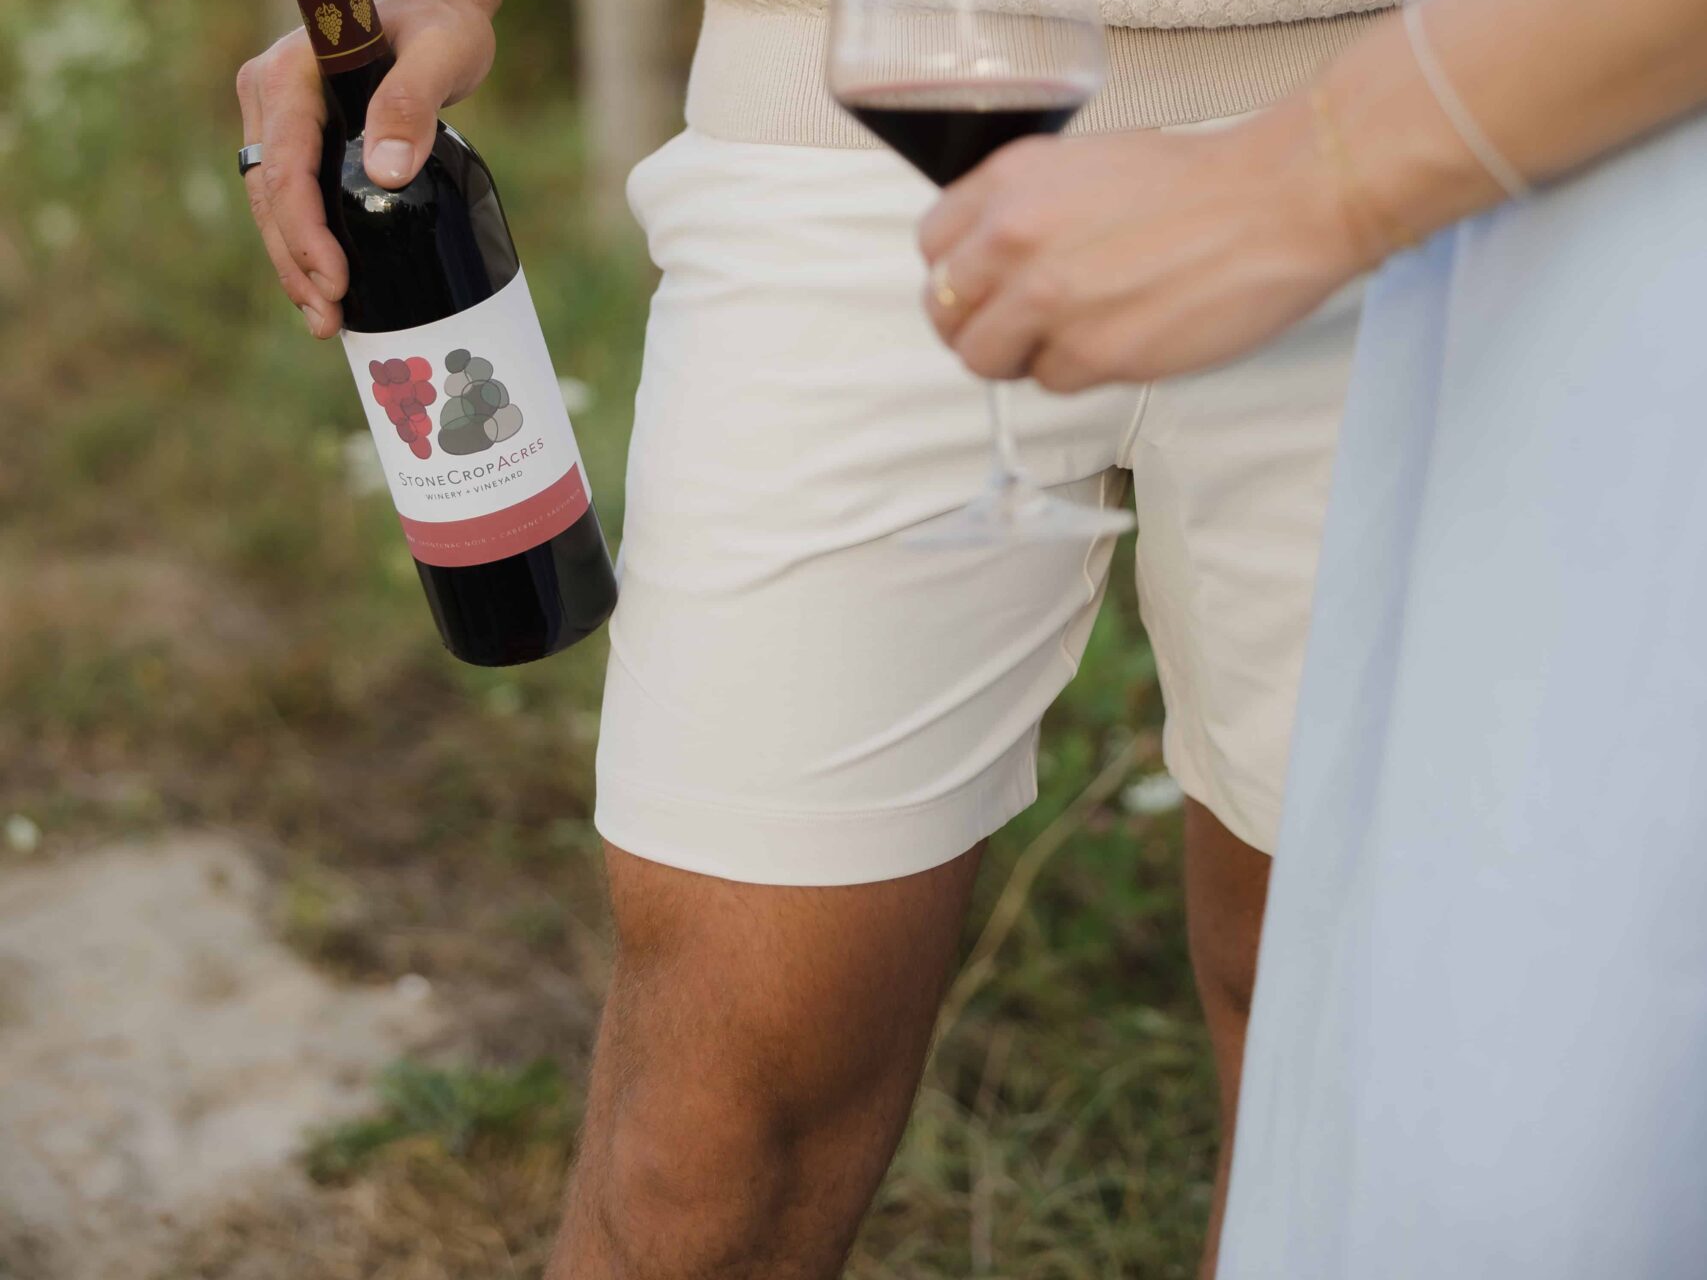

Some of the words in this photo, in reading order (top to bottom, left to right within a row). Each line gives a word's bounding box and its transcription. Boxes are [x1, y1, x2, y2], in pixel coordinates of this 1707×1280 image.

[426, 490, 462, 501] WINERY
[474, 470, 523, 494] VINEYARD
[419, 539, 462, 549] ONTENAC
